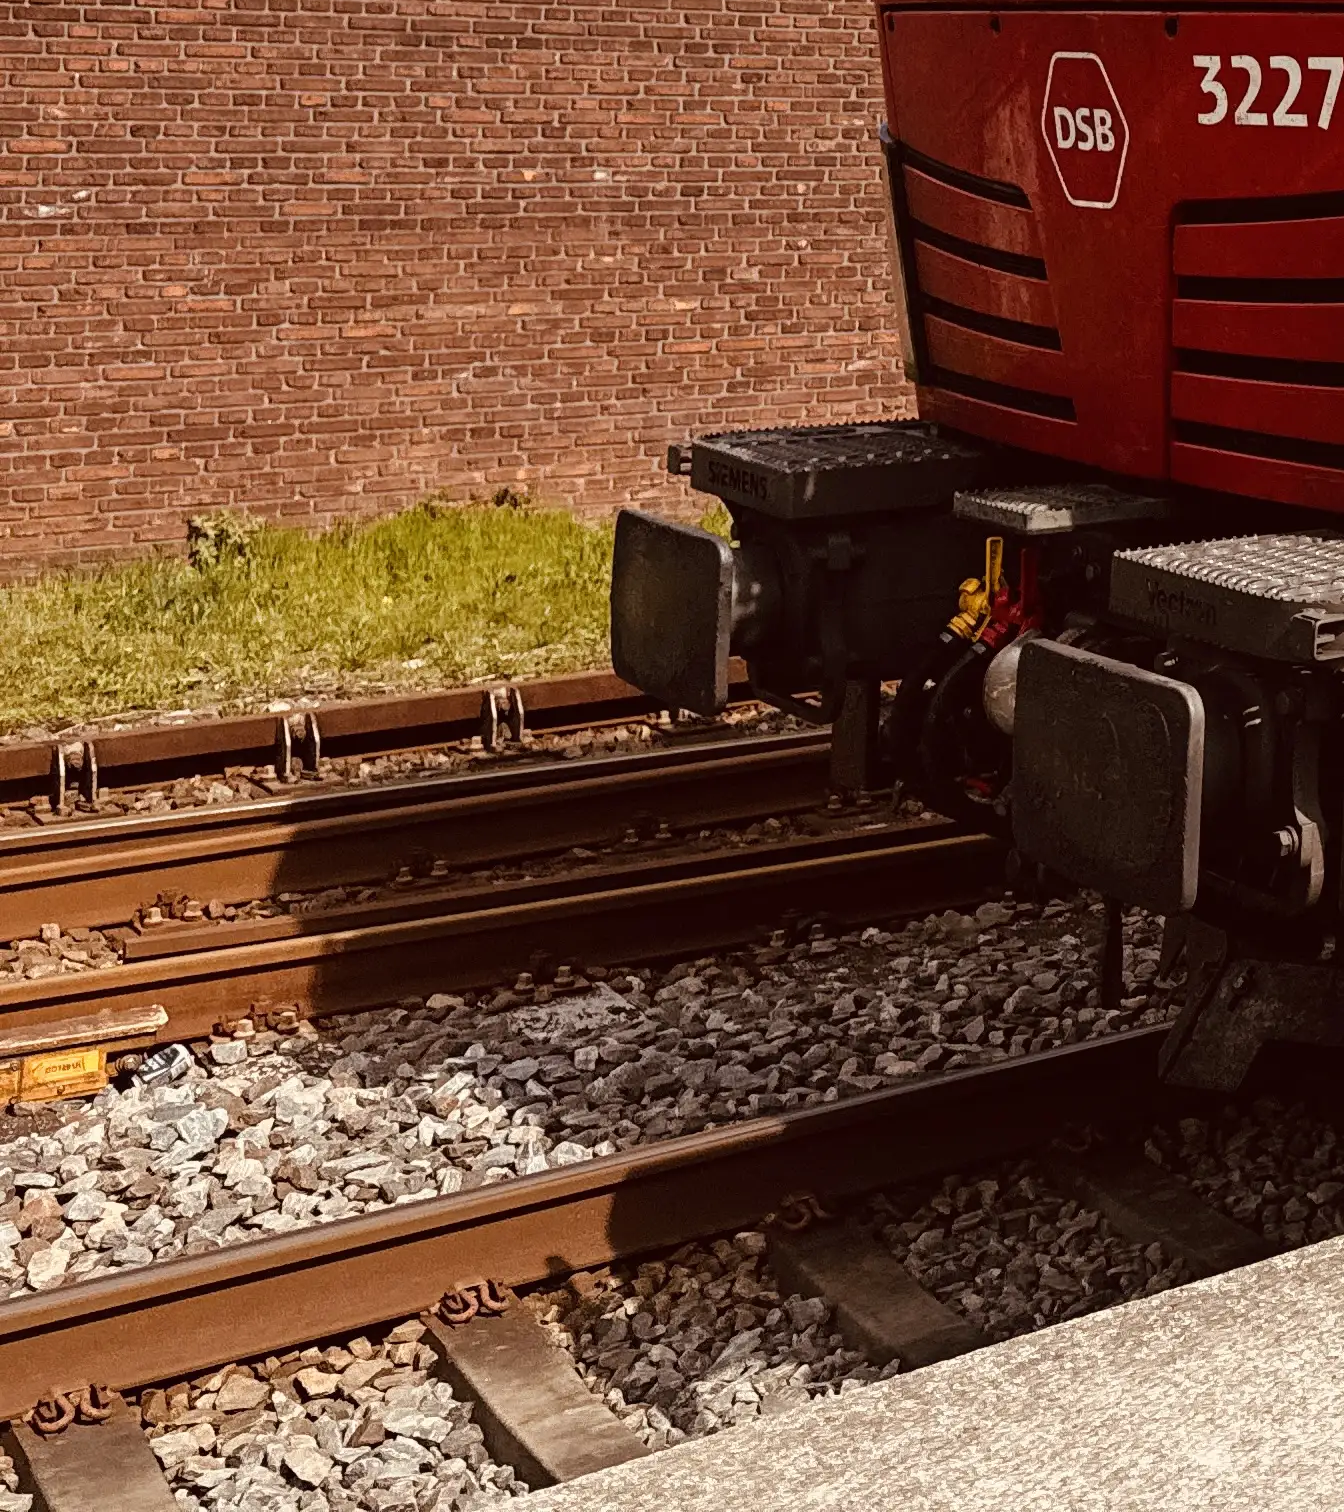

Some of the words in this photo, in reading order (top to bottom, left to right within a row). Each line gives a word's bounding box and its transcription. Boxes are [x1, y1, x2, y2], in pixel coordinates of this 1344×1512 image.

[1192, 54, 1344, 131] 3227
[1053, 106, 1115, 152] DSB
[707, 460, 768, 501] SIEMENS
